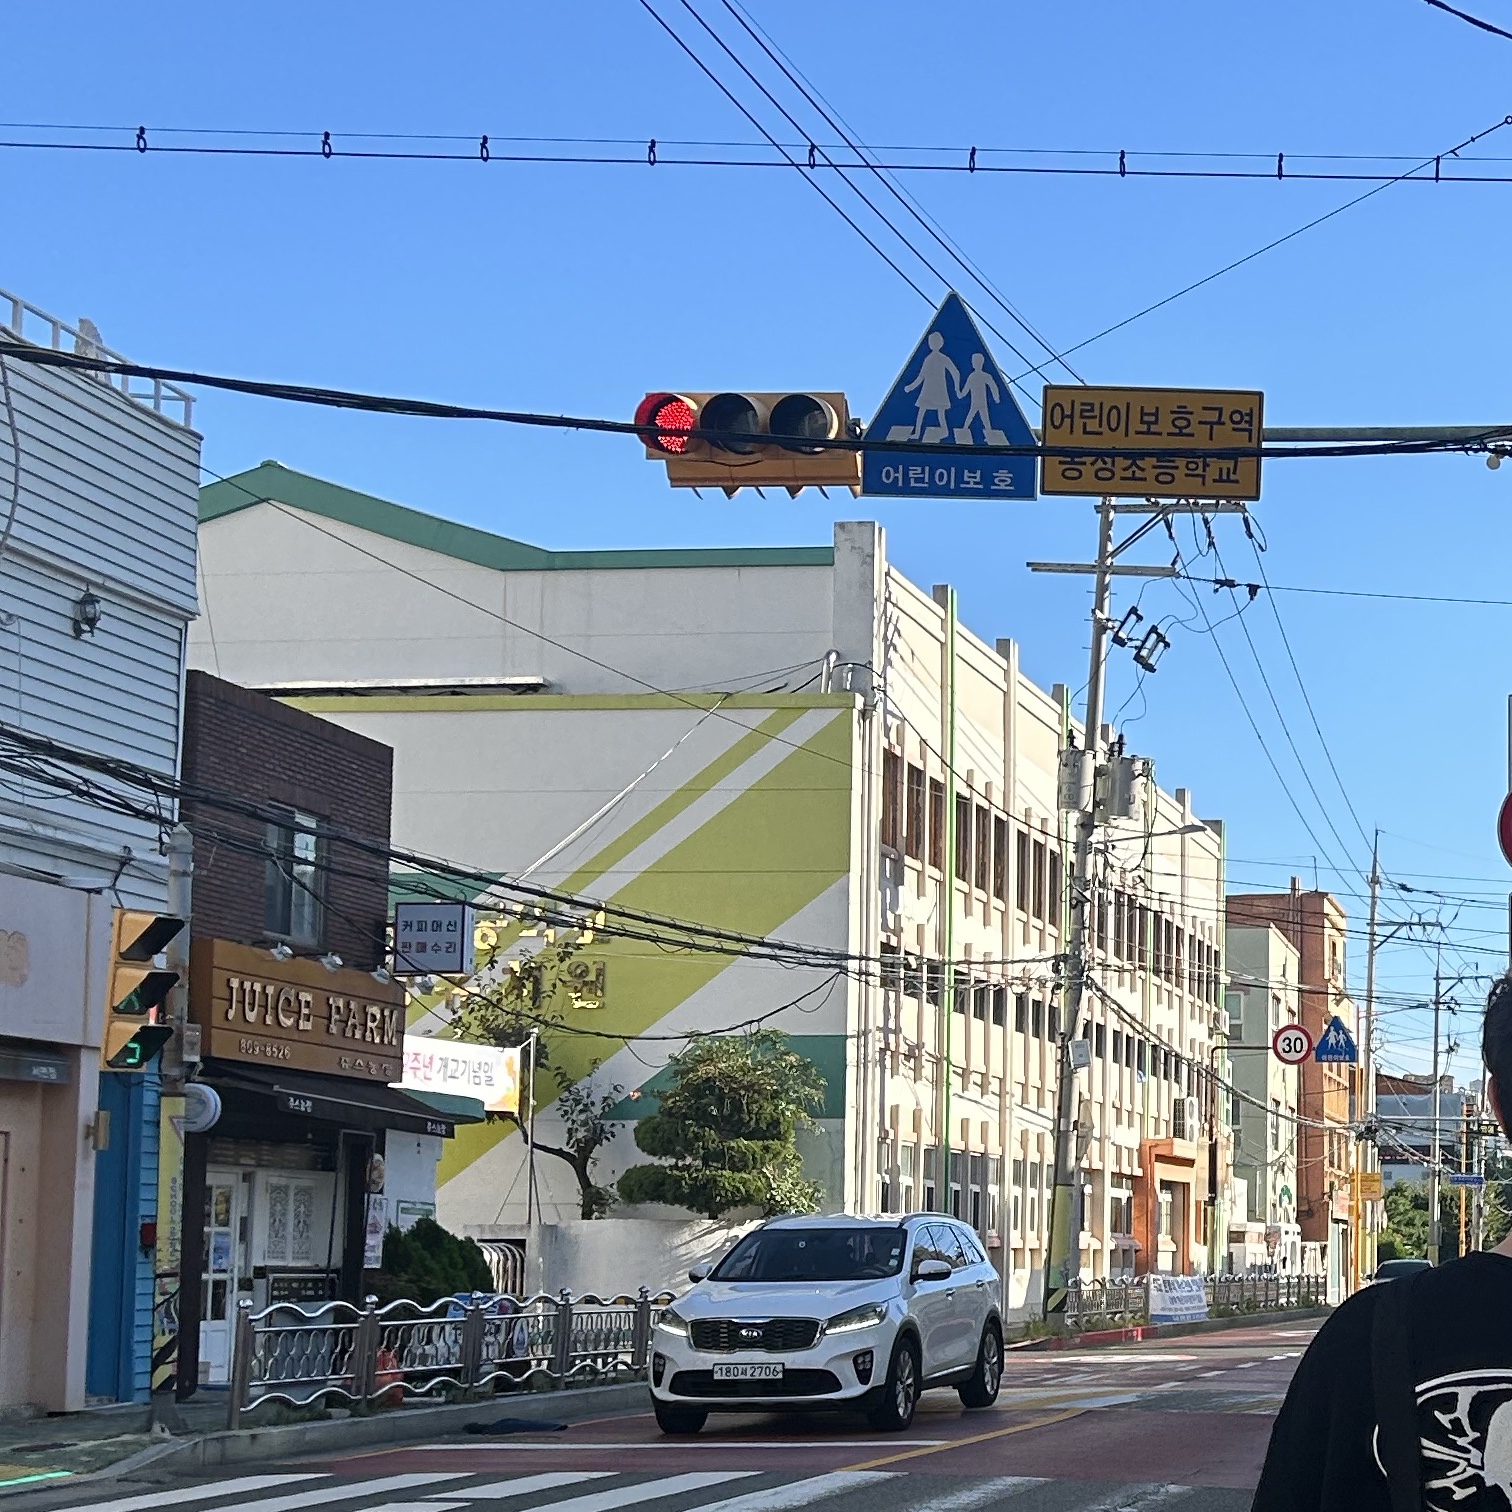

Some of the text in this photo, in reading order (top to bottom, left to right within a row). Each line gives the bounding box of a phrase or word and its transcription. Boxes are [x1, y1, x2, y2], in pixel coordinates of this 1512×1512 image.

[1049, 399, 1254, 443] 어린이보호구역
[880, 464, 1016, 492] 어린이보호
[401, 919, 457, 933] 커피머신
[401, 941, 457, 954] 판매수리
[227, 977, 398, 1046] JUICE FARM
[1282, 1037, 1304, 1054] 30
[437, 1056, 495, 1087] 개교기념일
